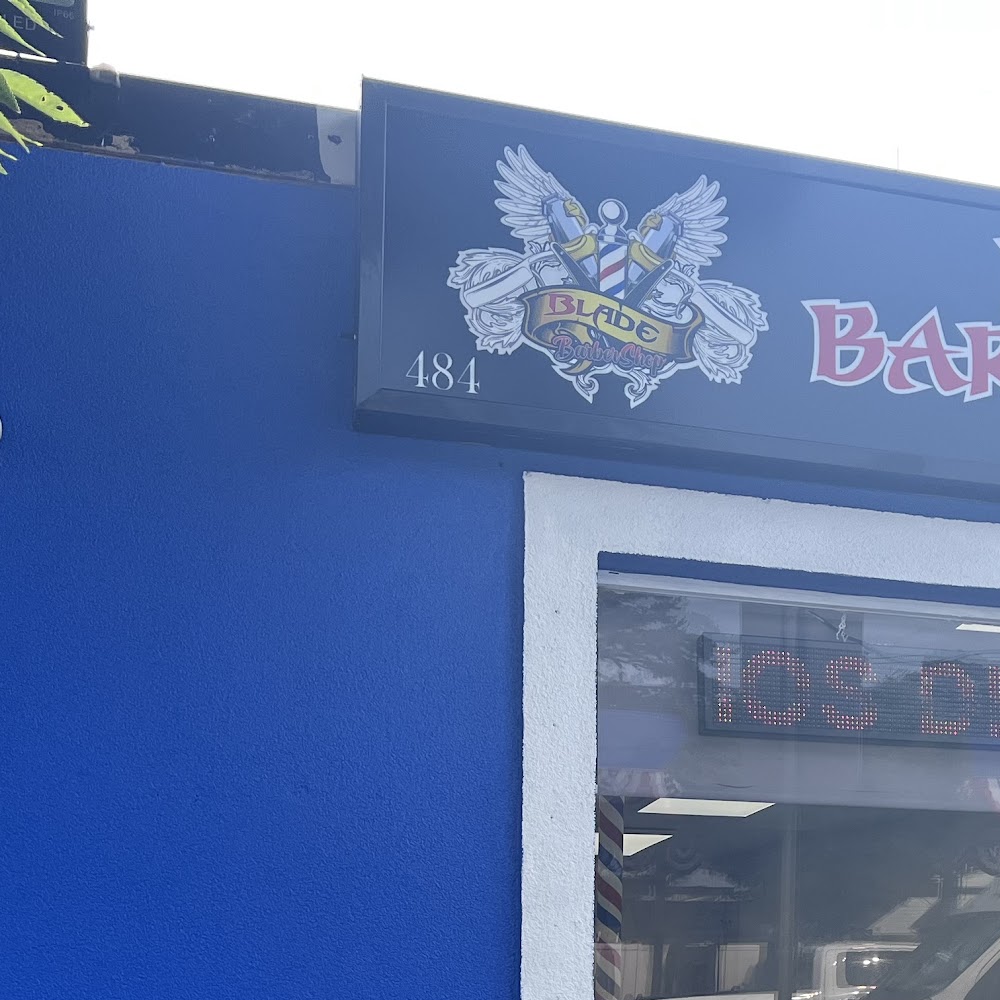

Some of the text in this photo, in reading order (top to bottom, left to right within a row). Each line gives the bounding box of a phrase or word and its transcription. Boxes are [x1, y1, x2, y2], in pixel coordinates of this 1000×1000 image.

[543, 293, 661, 343] BLADE
[405, 350, 480, 394] 484
[551, 334, 668, 378] BarberShop
